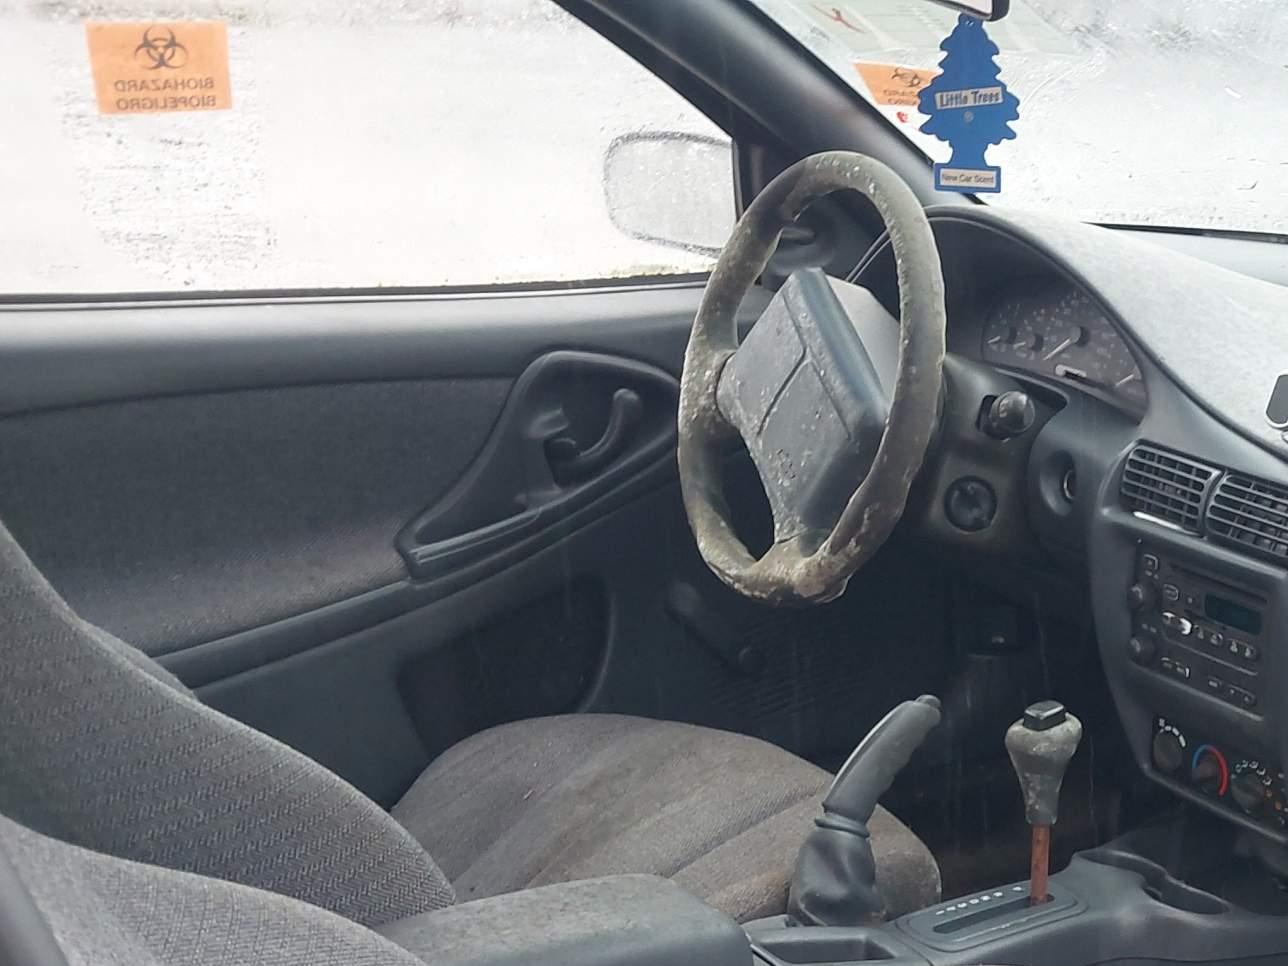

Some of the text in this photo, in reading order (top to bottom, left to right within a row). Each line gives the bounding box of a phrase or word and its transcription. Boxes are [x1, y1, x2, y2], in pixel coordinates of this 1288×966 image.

[940, 90, 1000, 107] Little Trees
[959, 173, 973, 183] Car
[974, 174, 995, 184] Scent
